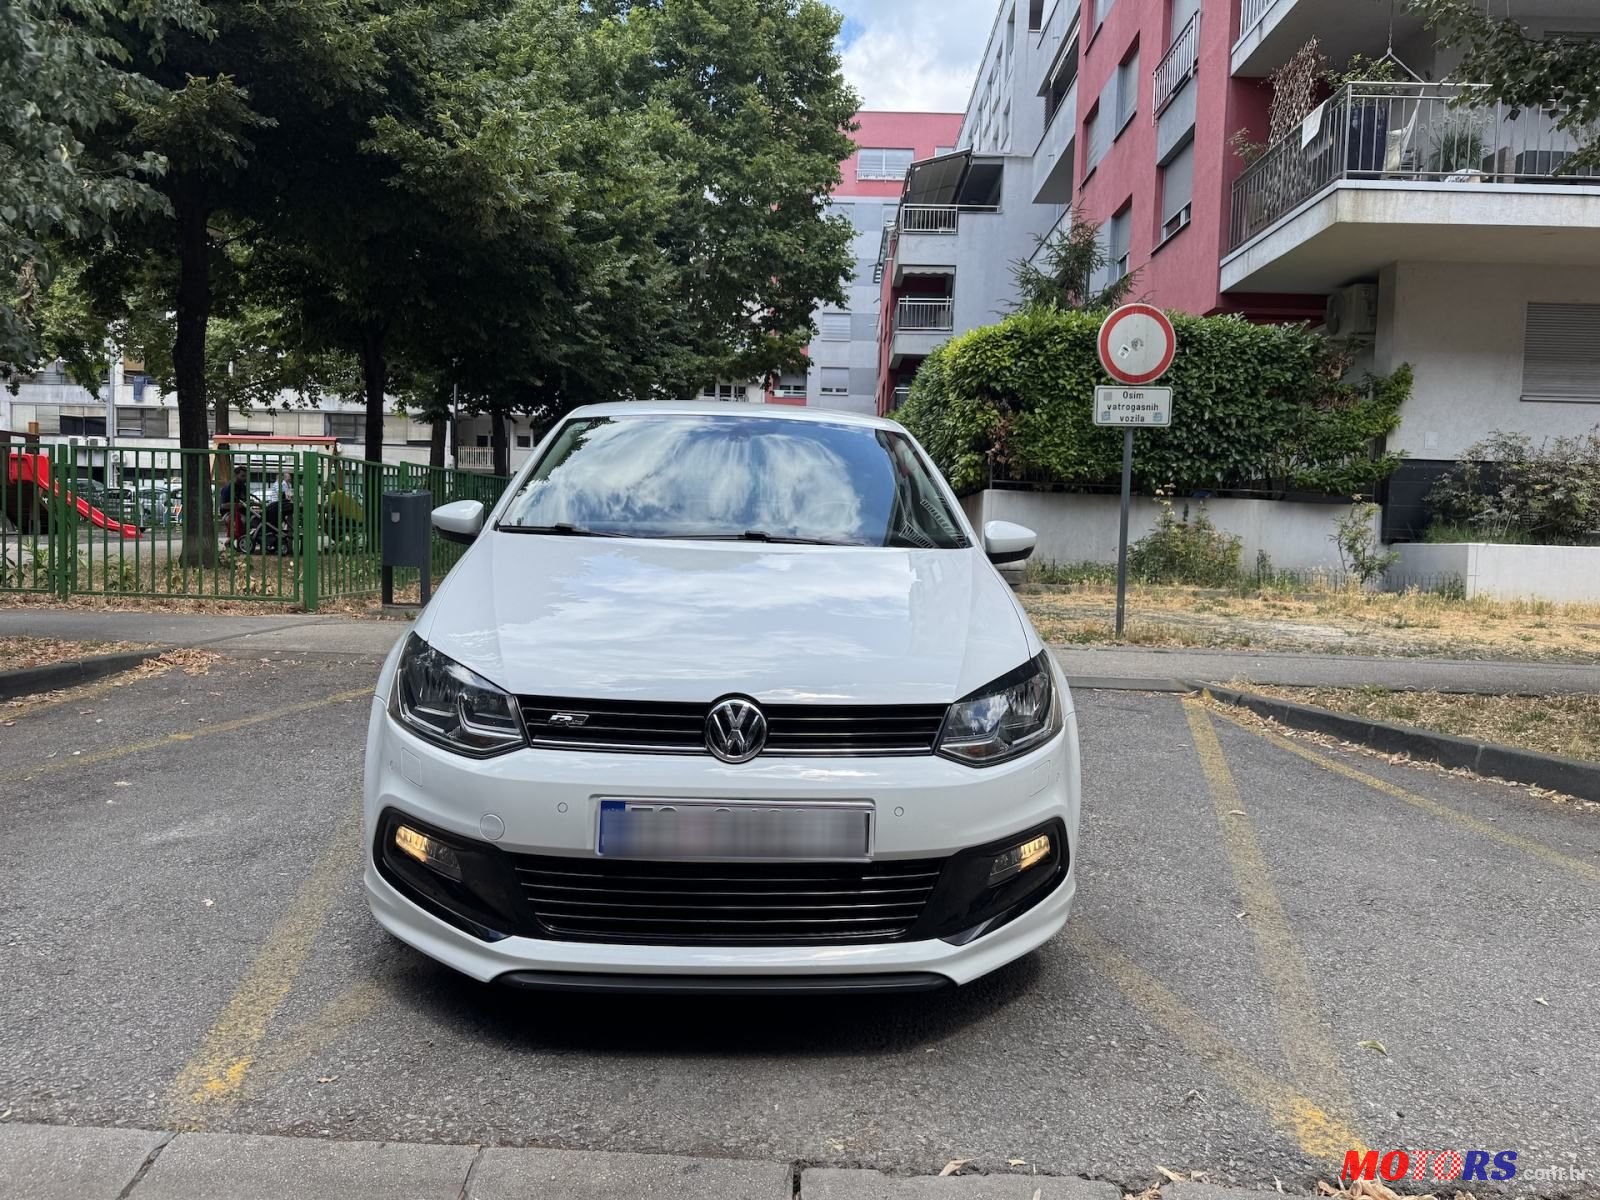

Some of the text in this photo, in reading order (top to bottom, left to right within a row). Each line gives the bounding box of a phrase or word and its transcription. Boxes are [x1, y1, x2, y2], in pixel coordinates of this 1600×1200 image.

[1122, 391, 1144, 400] Osim
[1106, 403, 1159, 412] vatrogasnih
[1119, 414, 1145, 422] vozila
